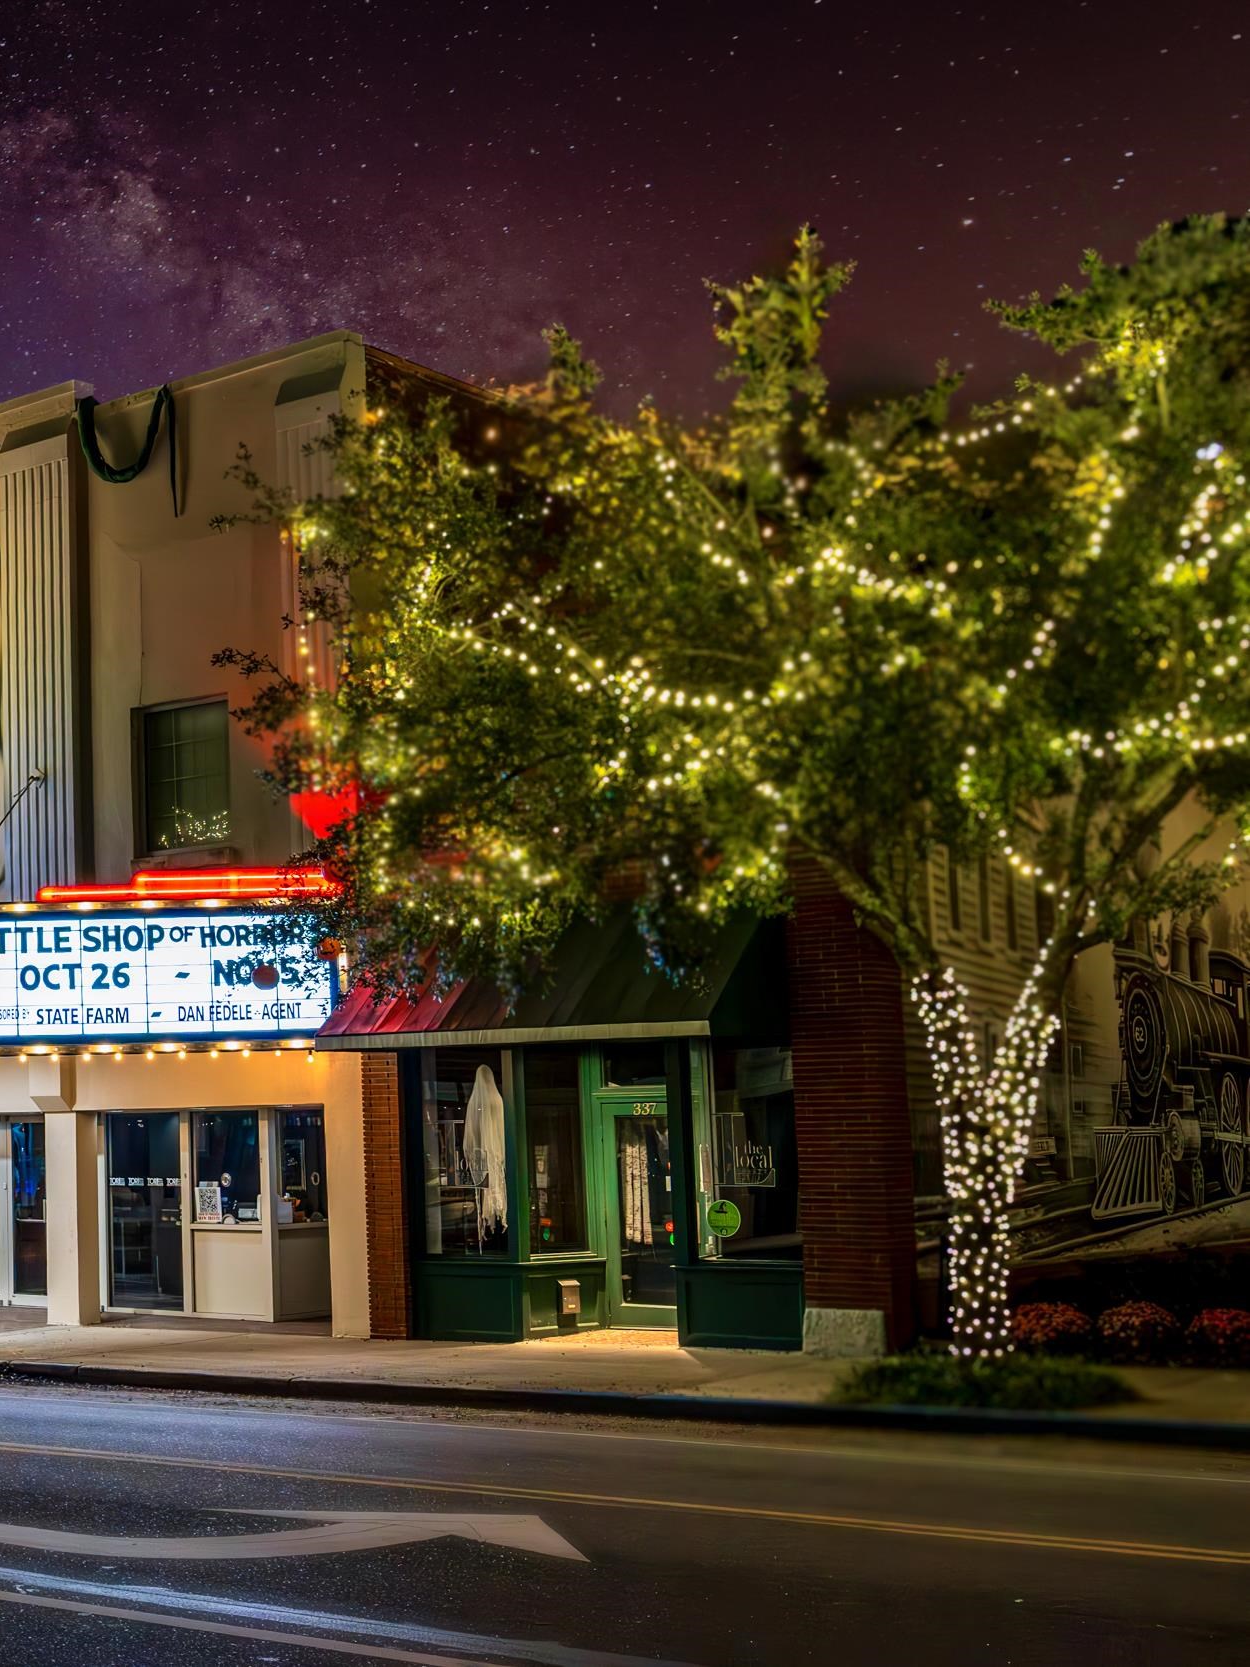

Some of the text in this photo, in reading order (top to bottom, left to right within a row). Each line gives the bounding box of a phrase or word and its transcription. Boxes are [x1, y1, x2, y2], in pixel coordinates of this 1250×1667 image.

[82, 924, 165, 952] SHOP
[169, 926, 196, 943] OF
[20, 963, 82, 991] OCT
[91, 962, 131, 990] 26
[36, 1007, 79, 1025] STATE
[86, 1007, 129, 1024] FARM
[178, 1005, 204, 1022] DAN
[209, 1004, 252, 1021] FEDELE
[262, 1002, 301, 1020] AGENT
[632, 1102, 657, 1116] 337
[735, 1145, 773, 1169] local
[744, 1140, 764, 1155] the
